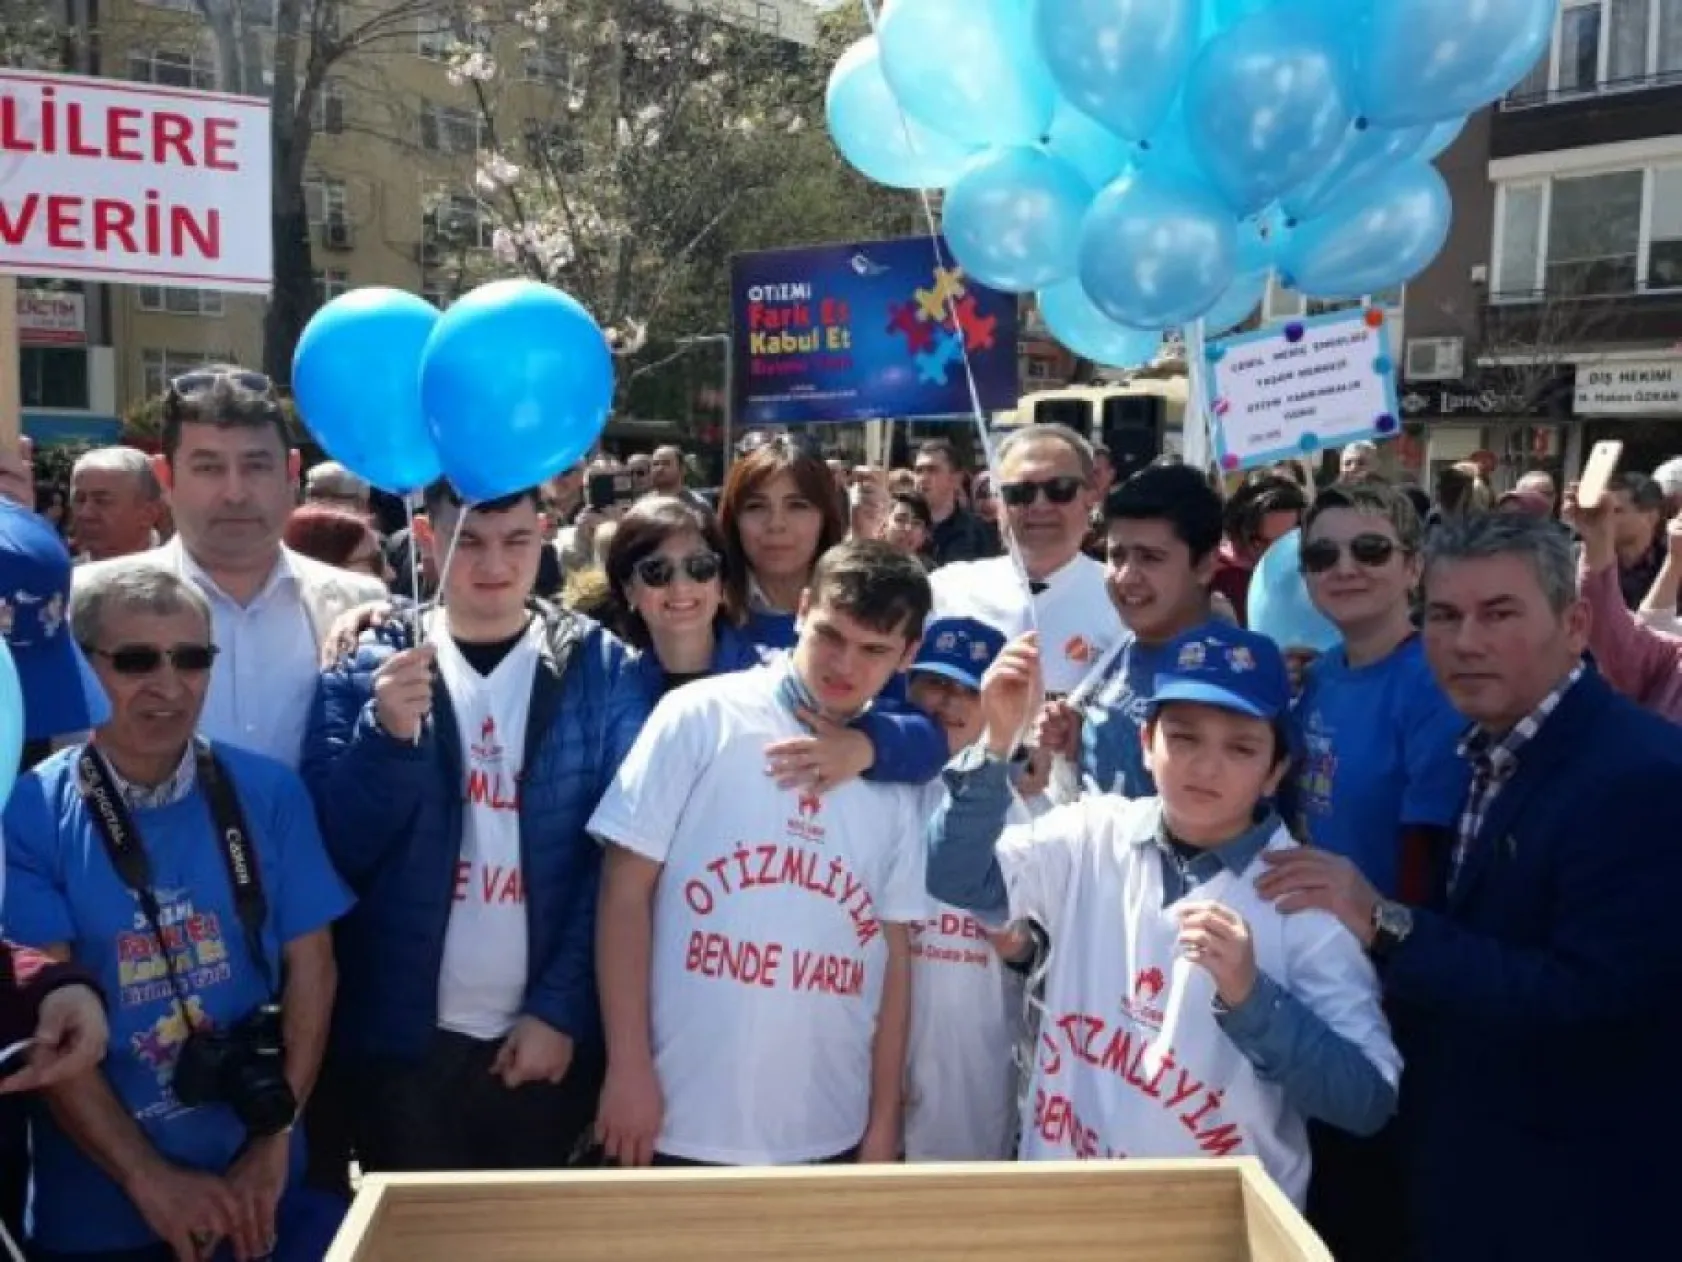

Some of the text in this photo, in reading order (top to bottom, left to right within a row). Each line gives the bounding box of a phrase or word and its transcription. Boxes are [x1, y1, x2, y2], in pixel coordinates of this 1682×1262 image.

[0, 189, 220, 259] VERİN
[750, 326, 852, 355] Kabul Et
[686, 930, 864, 996] BENDE VARIM
